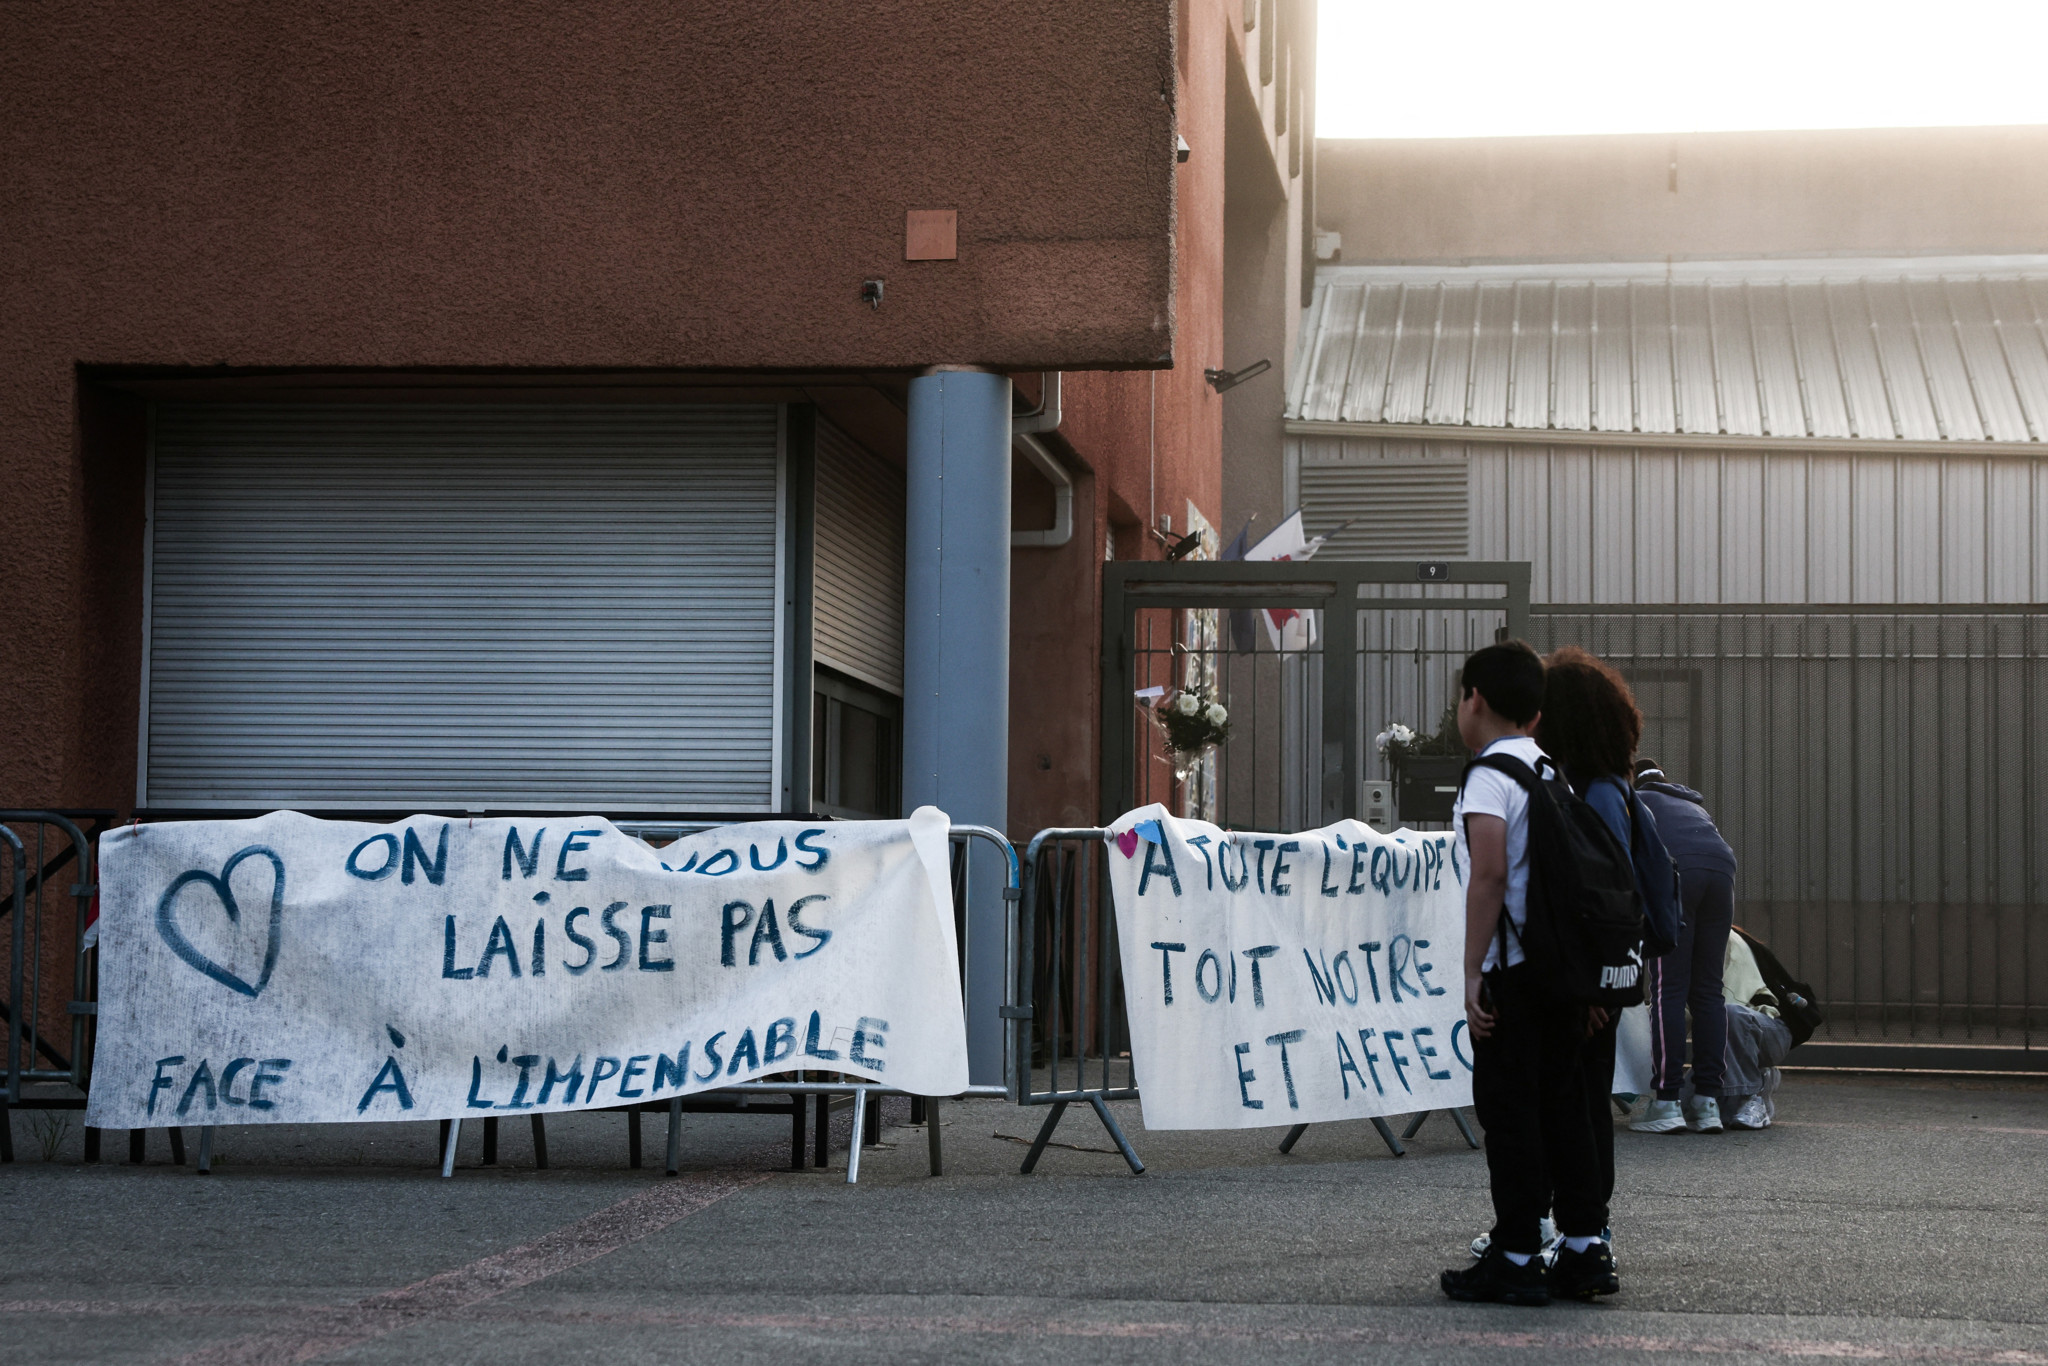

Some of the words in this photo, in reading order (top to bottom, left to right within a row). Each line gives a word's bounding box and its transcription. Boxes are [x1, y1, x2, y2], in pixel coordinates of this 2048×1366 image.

[1429, 566, 1436, 577] 9
[345, 823, 450, 886] ON
[501, 825, 604, 882] NE
[720, 894, 833, 968] PAS
[1303, 933, 1447, 1008] NOTRE
[1599, 963, 1639, 989] PUMA
[146, 1055, 293, 1118] FACE
[358, 1023, 416, 1116] À
[466, 1010, 891, 1110] L'IMPENSABLE
[1234, 1028, 1307, 1111] ET
